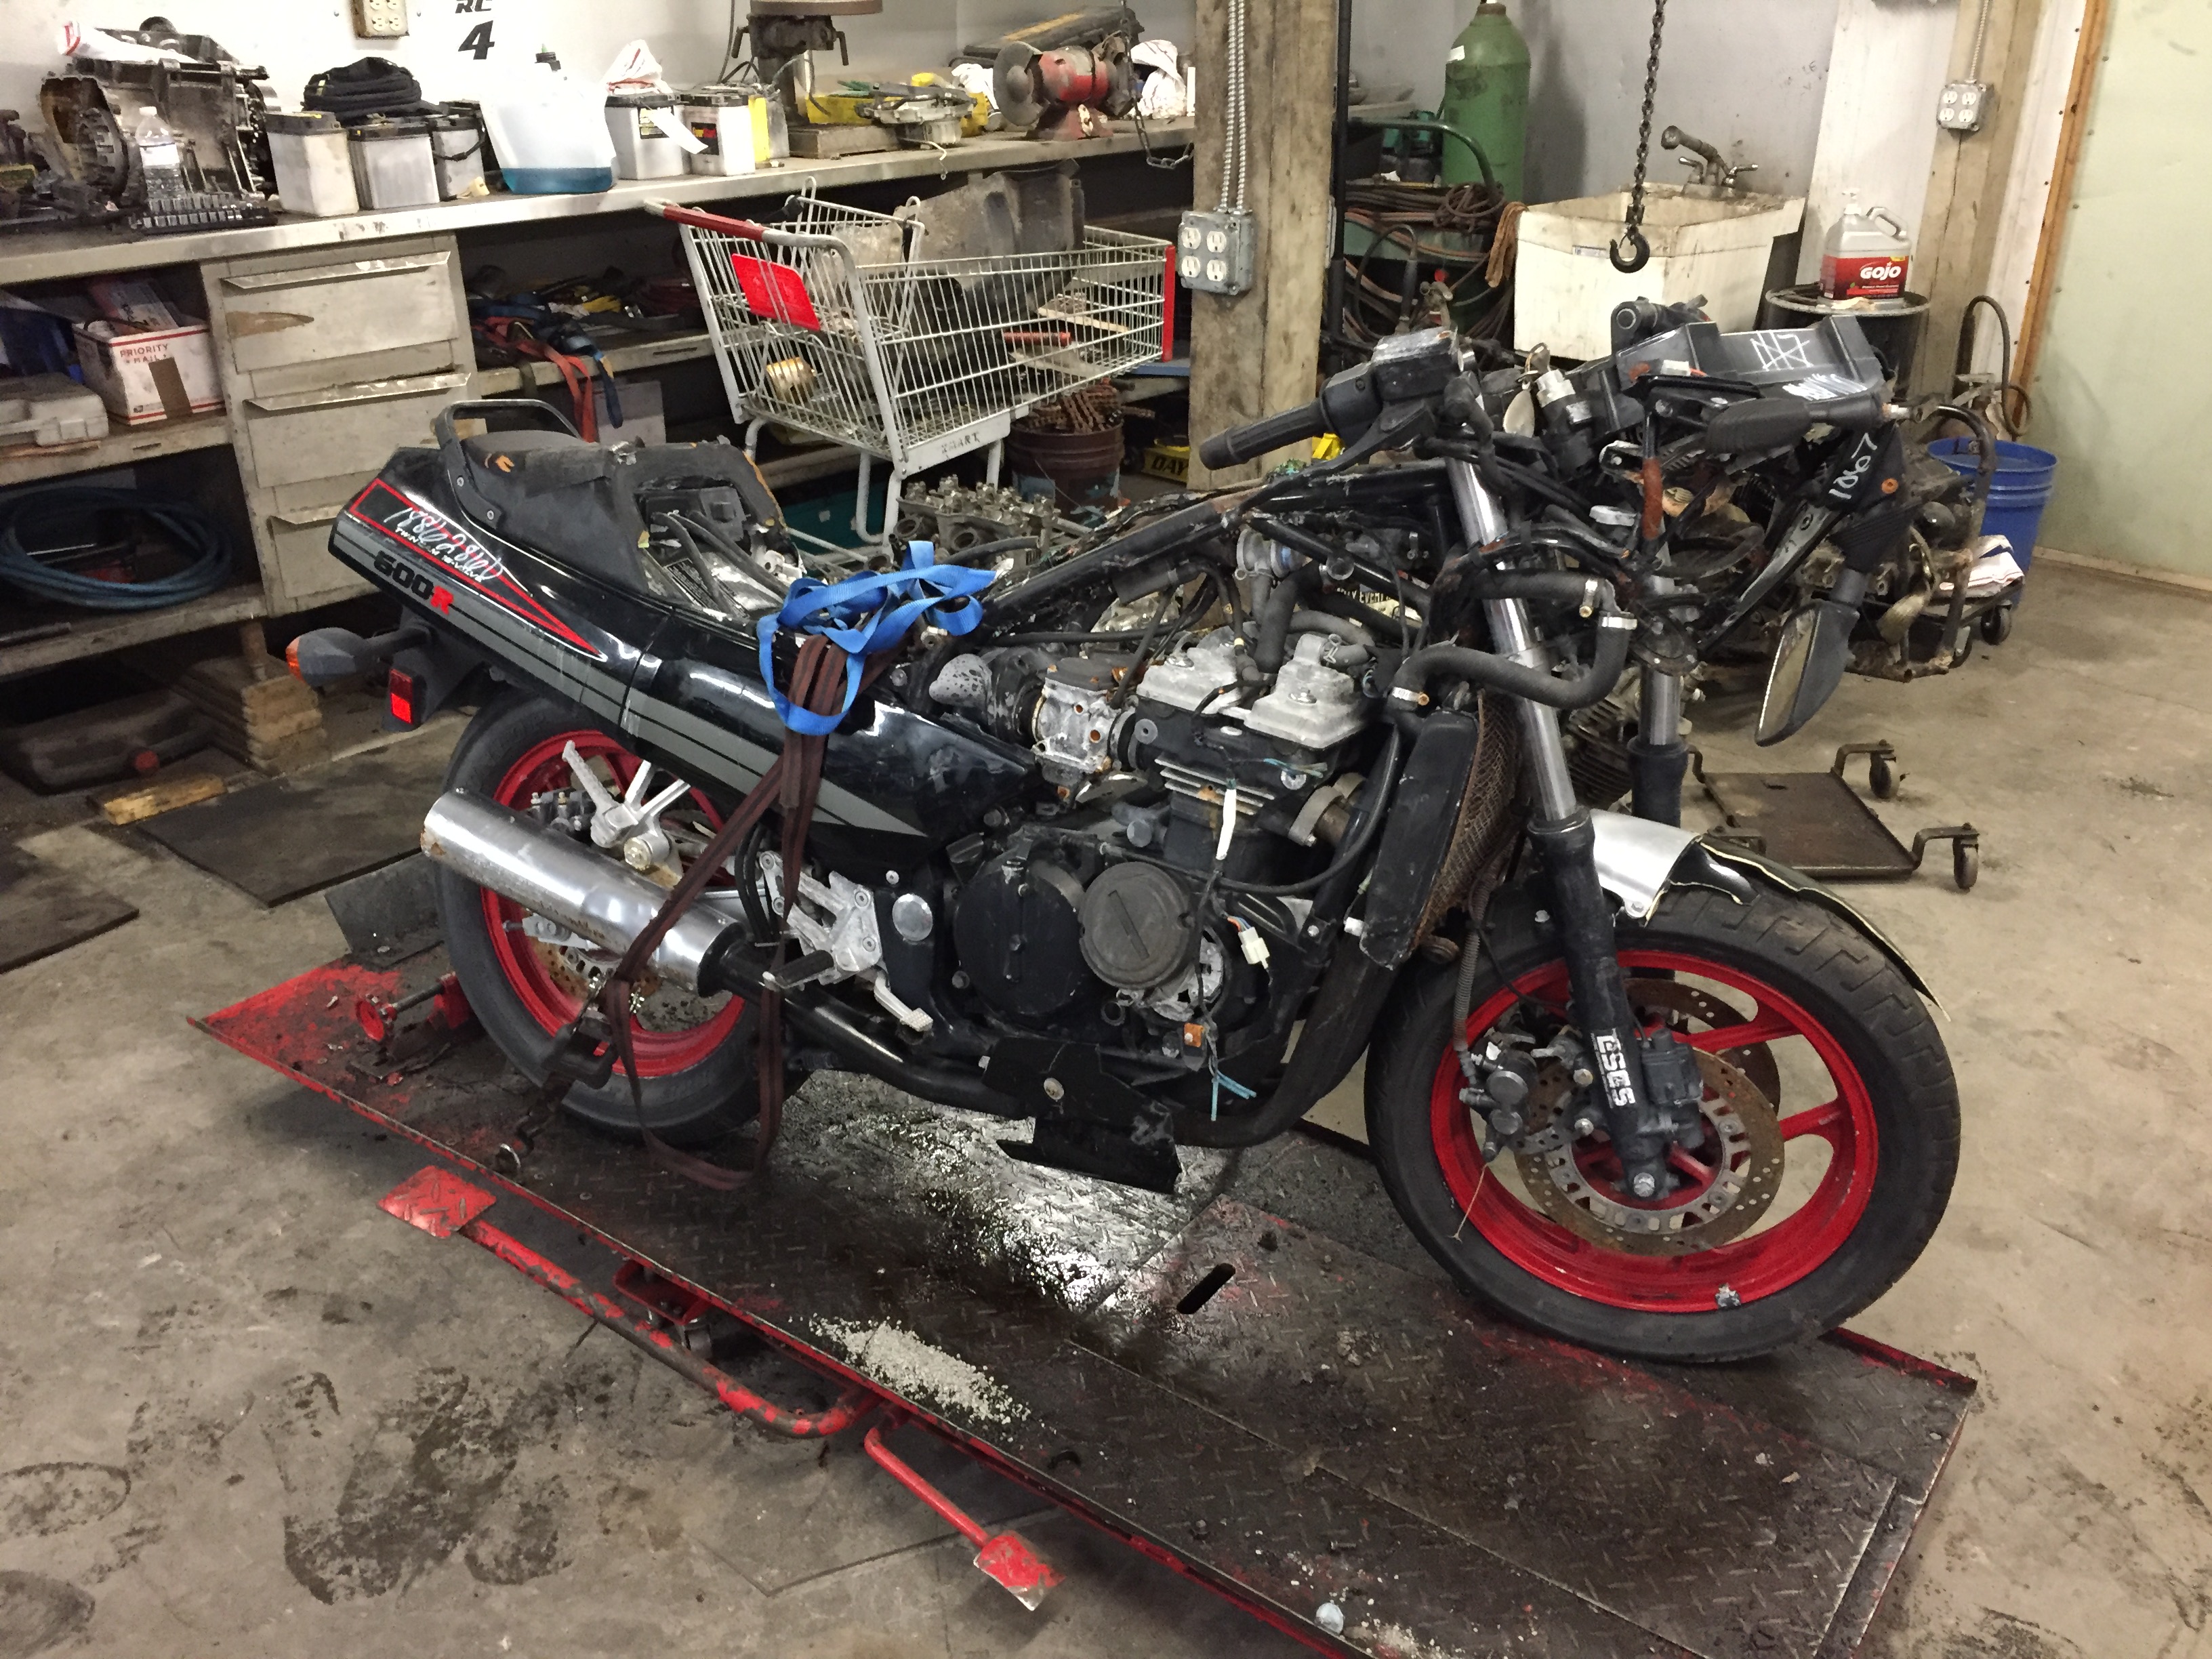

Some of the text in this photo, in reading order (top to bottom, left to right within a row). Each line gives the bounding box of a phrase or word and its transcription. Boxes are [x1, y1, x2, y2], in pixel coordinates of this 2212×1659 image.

[458, 20, 495, 60] 4
[1860, 262, 1902, 281] GOJO
[120, 343, 169, 358] PRIORITY
[134, 354, 160, 364] MAIL
[373, 550, 454, 615] 600R
